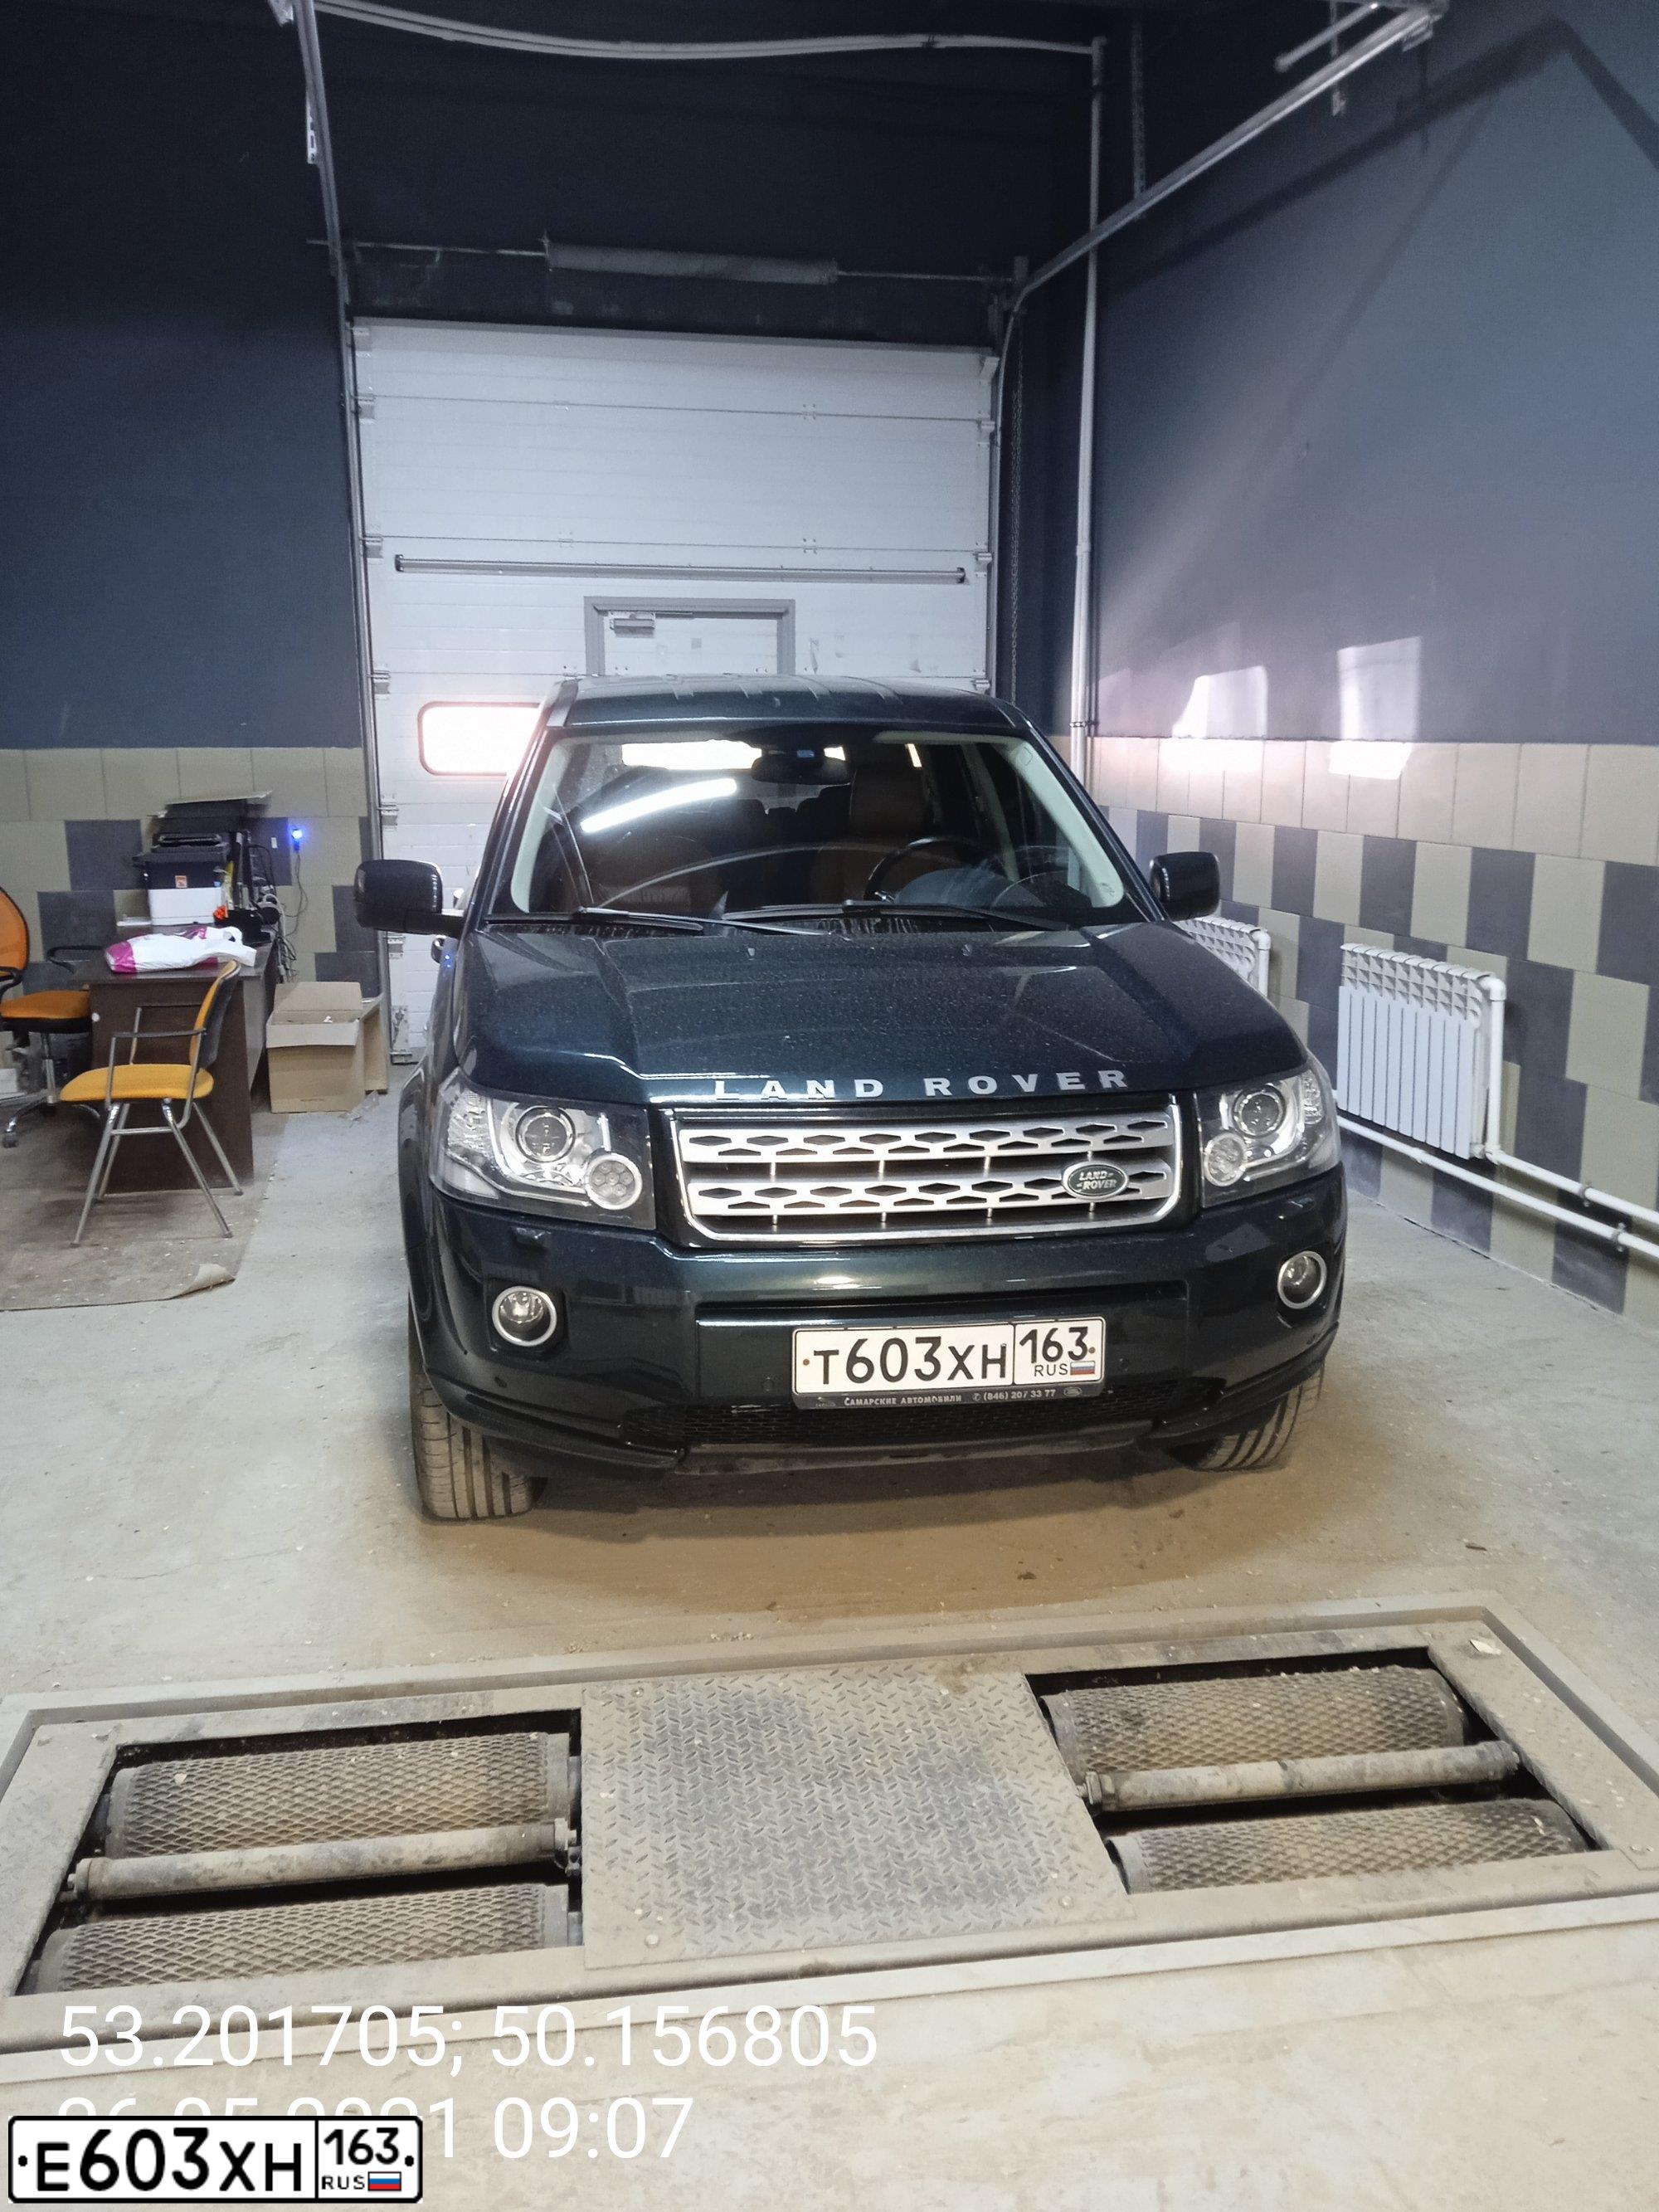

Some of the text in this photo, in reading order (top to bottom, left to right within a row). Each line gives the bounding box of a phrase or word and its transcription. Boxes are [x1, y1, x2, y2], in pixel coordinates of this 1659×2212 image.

[714, 1069, 1128, 1100] LAND ROVER
[813, 1326, 1089, 1385] Т603ХН 163
[1034, 1363, 1068, 1377] RUS
[1030, 1389, 1043, 1398] 33
[1044, 1388, 1056, 1397] 77
